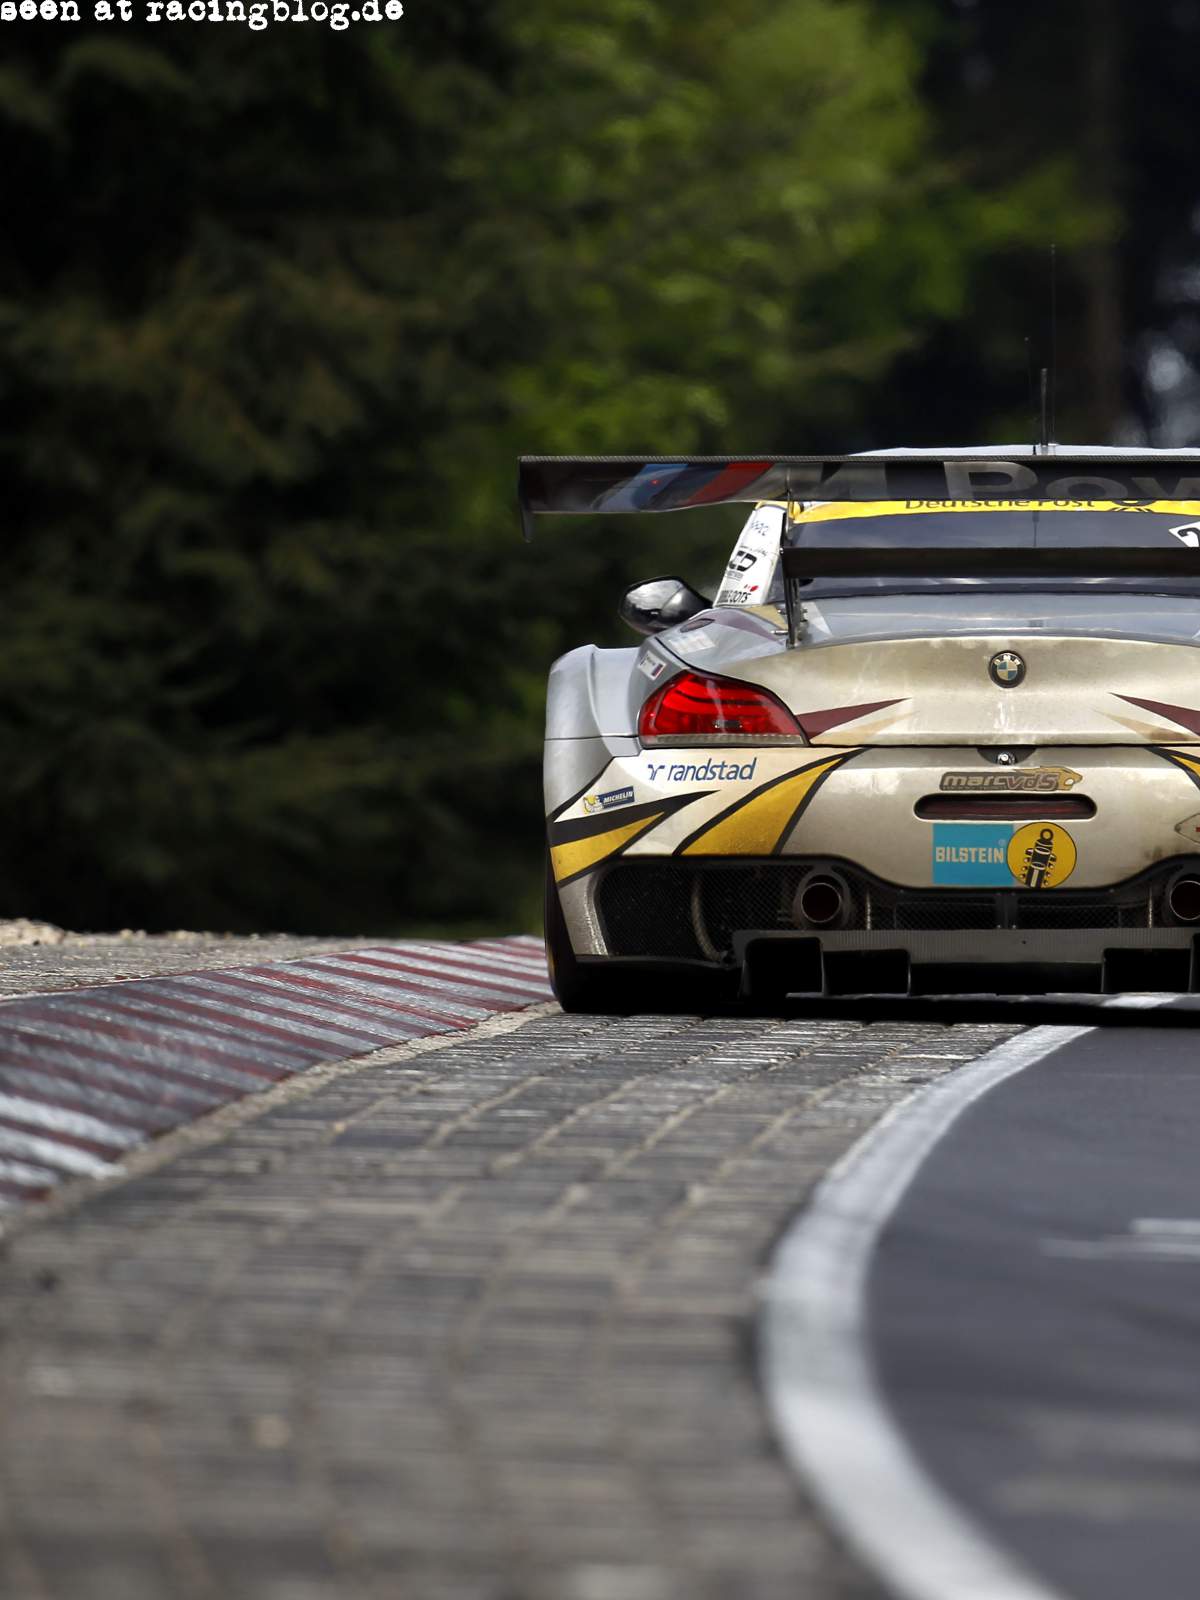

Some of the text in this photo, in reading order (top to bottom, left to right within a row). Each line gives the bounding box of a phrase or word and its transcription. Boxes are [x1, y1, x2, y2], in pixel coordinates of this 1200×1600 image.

[668, 757, 757, 782] randstad
[603, 791, 634, 804] MICHELIN
[935, 846, 1004, 864] BILSTEIN
